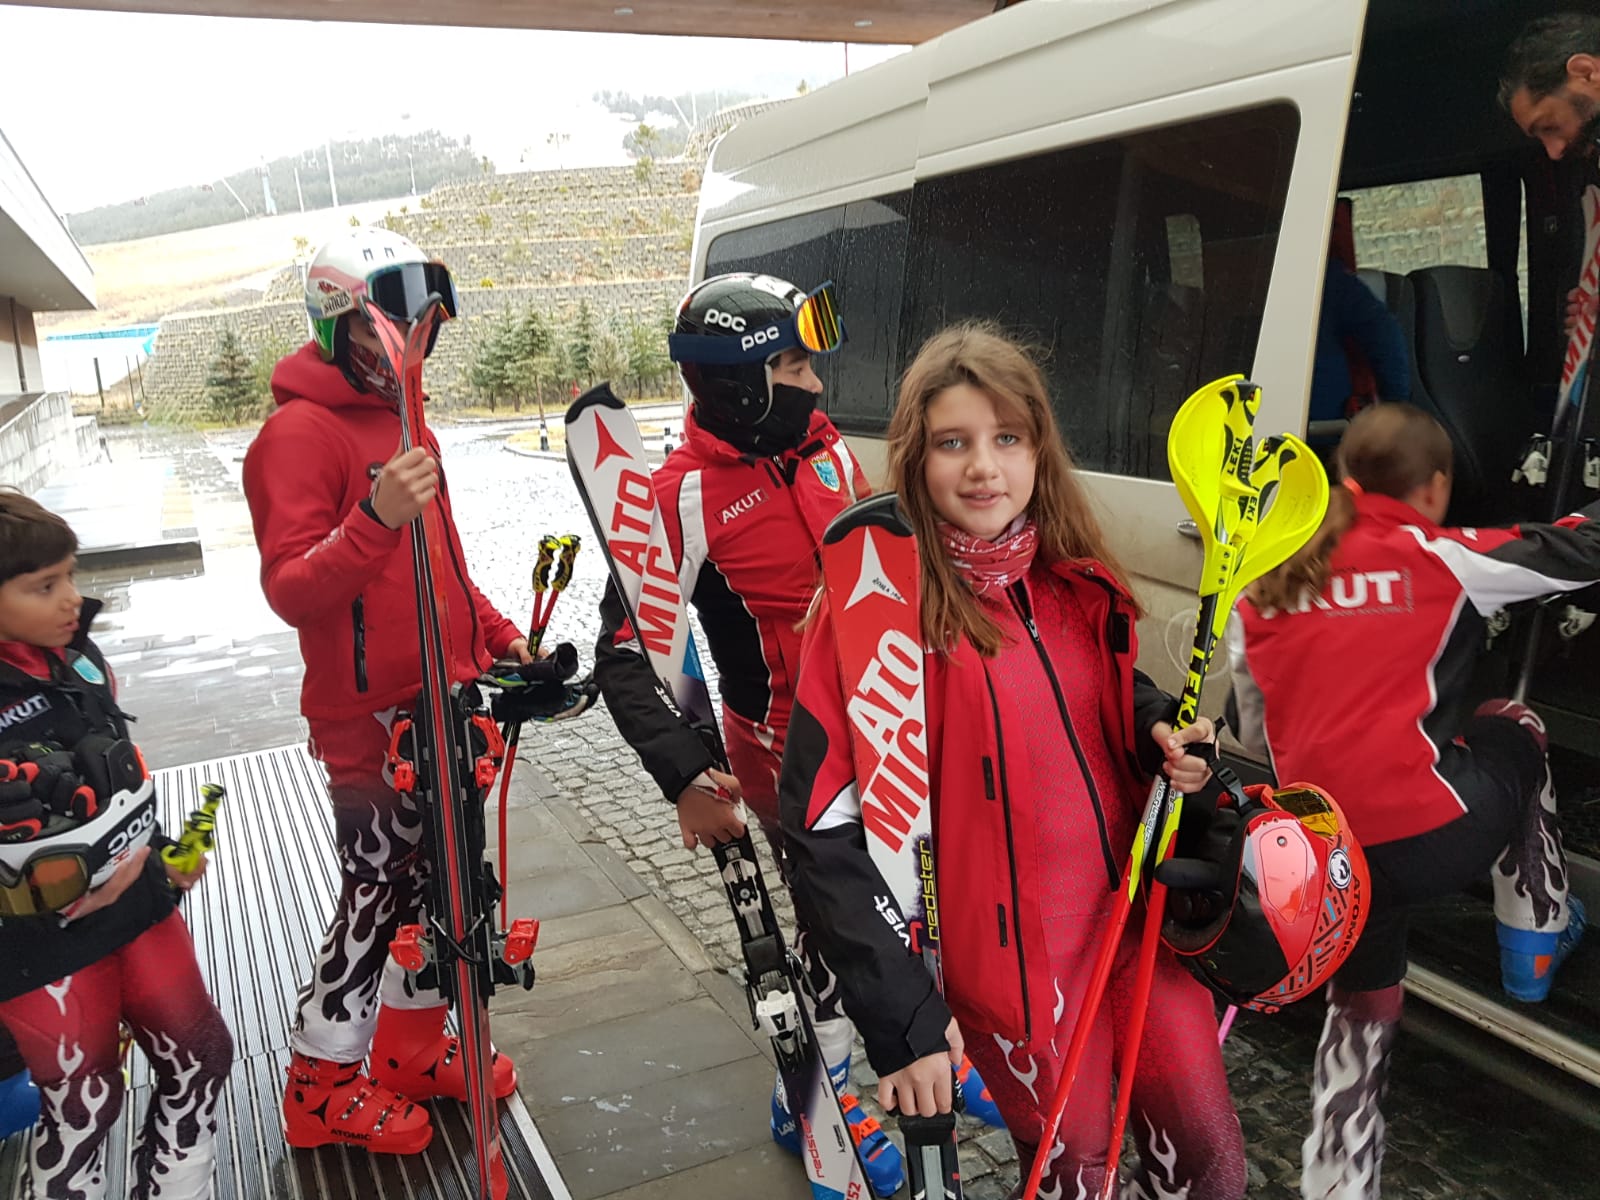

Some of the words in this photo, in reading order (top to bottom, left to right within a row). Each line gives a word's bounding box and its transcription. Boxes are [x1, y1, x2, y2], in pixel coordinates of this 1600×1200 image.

[1227, 437, 1244, 475] LEKI
[721, 488, 762, 524] AKUT
[847, 628, 923, 760] ATO
[919, 840, 939, 940] redster
[873, 896, 910, 947] vist
[1337, 874, 1360, 959] ATOMIC
[331, 1128, 372, 1141] ATOMIC
